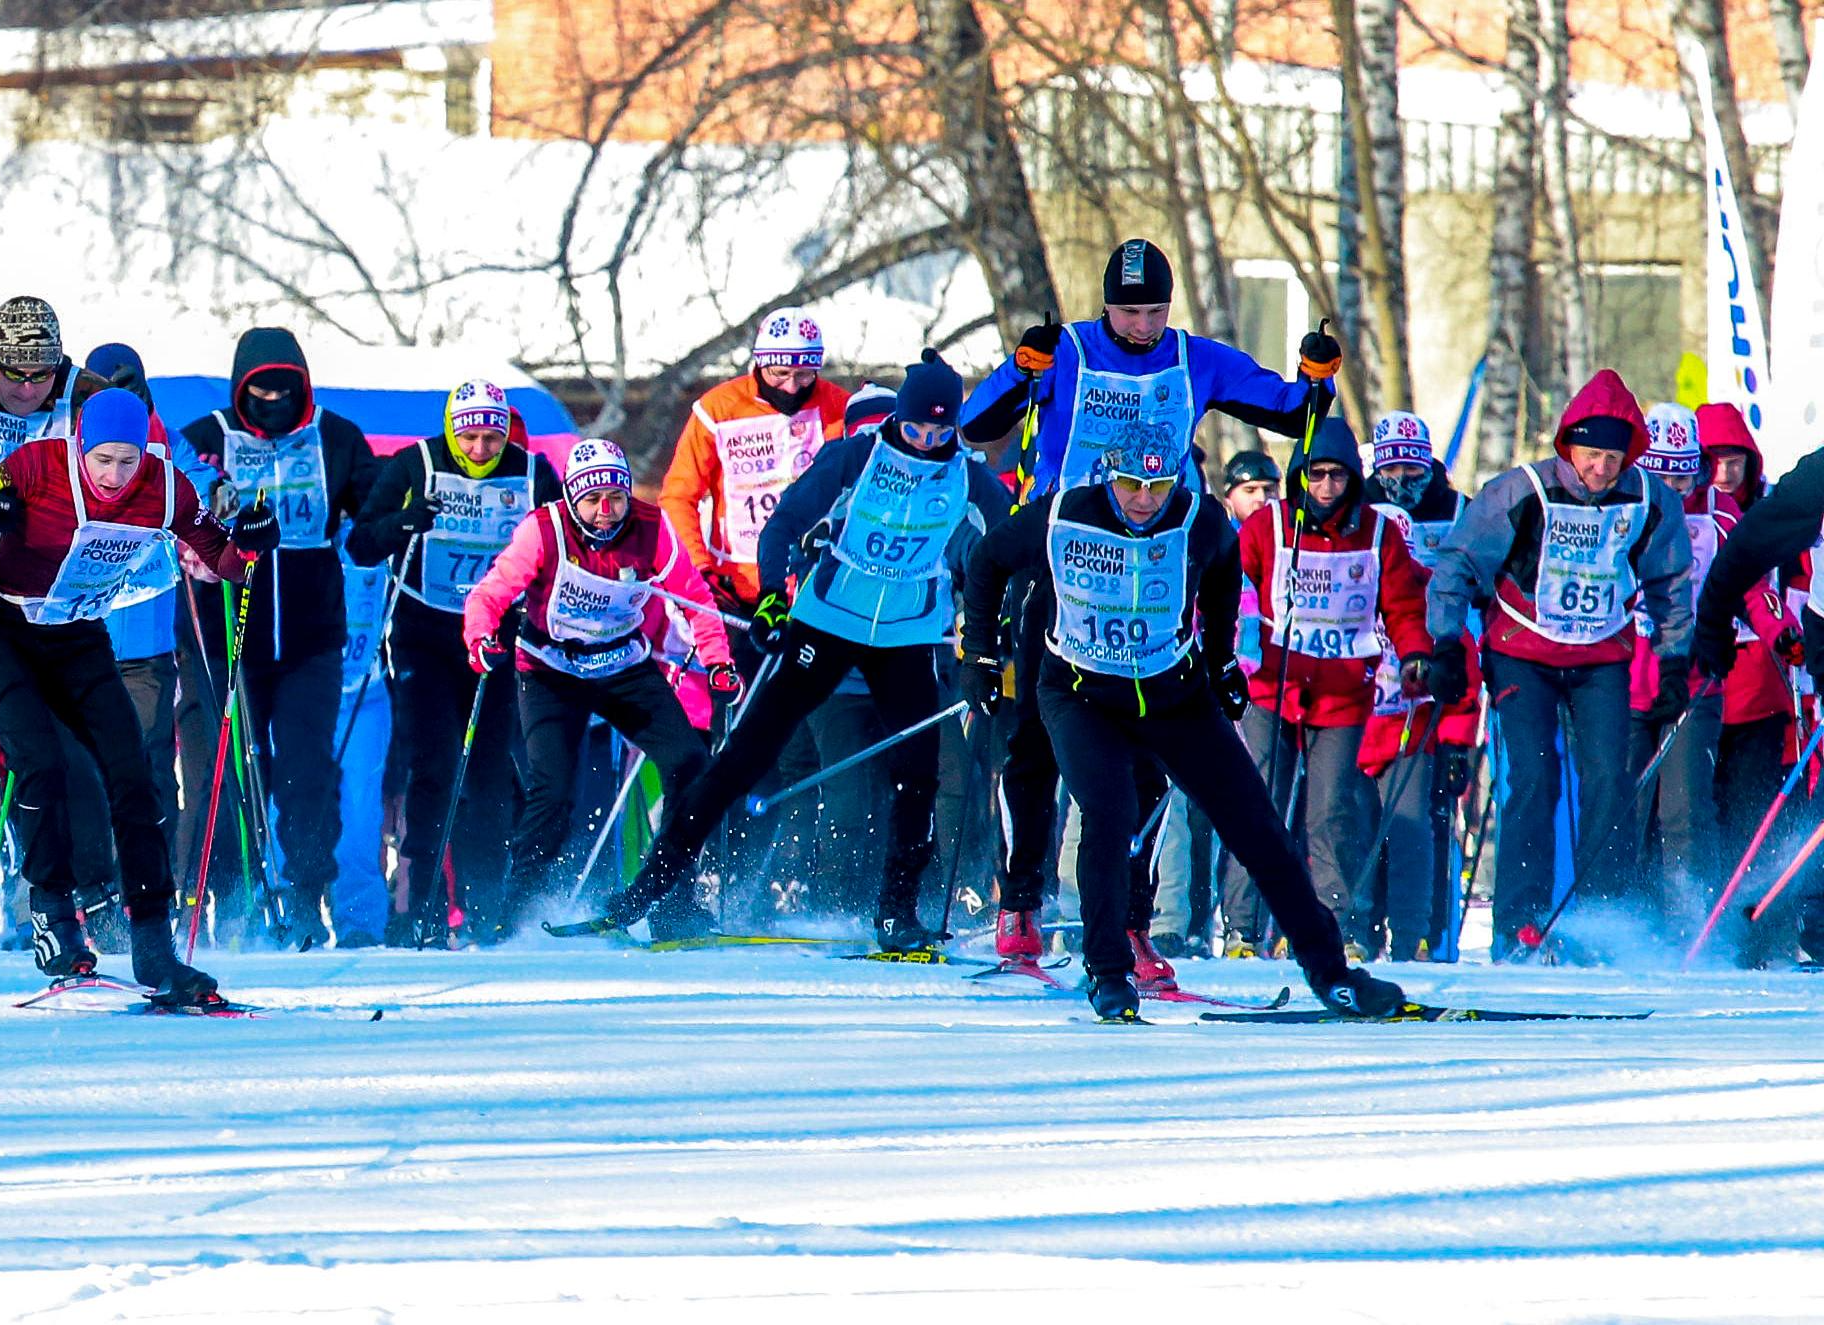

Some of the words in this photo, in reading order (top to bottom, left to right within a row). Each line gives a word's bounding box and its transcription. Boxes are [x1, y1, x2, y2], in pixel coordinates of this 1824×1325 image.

[1084, 387, 1141, 407] ЛЫЖНЯ
[1083, 403, 1140, 422] РОССИИ
[726, 431, 773, 448] ЛЫЖНЯ
[728, 444, 775, 461] РОССИИ
[732, 457, 776, 475] 2022
[438, 503, 483, 519] ОССИИ
[434, 515, 482, 534] 2022
[1550, 519, 1600, 537] ЛЫЖНЯ
[84, 538, 142, 553] ЛЫЖНЯ
[865, 531, 930, 564] 657
[1549, 532, 1600, 548] РОССИИ
[1063, 539, 1125, 561] ЛЫЖНЯ
[1064, 553, 1124, 576] РОССИИ
[1063, 568, 1121, 595] 2022
[560, 581, 611, 606] ЛЫЖНЯ
[1288, 594, 1330, 610] 022
[1560, 581, 1615, 615] 651
[238, 586, 251, 625] LEKI
[1082, 615, 1149, 650] 169
